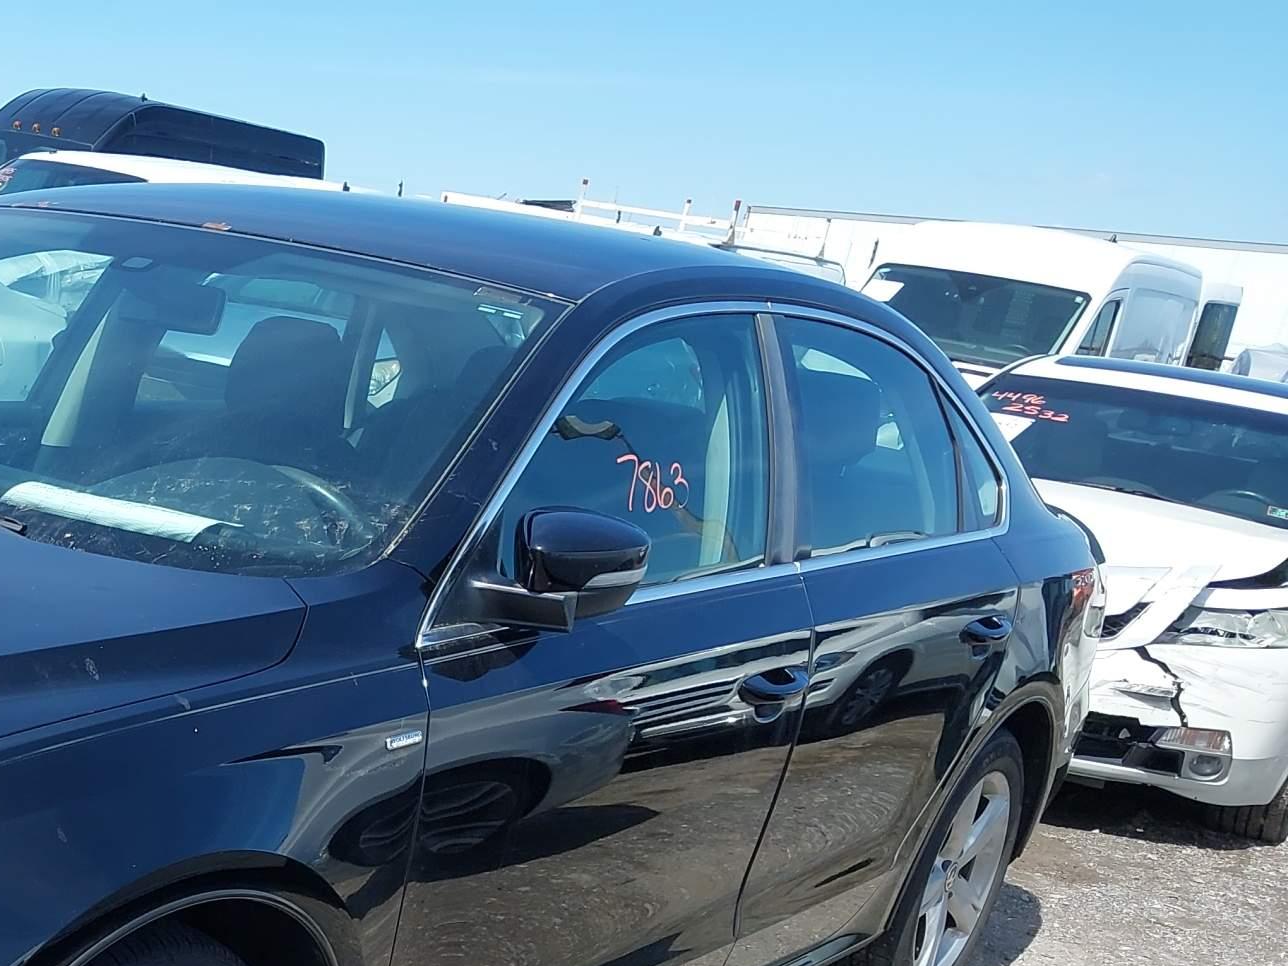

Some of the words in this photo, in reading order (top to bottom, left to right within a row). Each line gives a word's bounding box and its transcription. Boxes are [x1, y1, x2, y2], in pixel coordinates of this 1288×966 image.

[992, 390, 1047, 405] 4496
[1002, 402, 1070, 423] 2532
[616, 453, 690, 513] 7863
